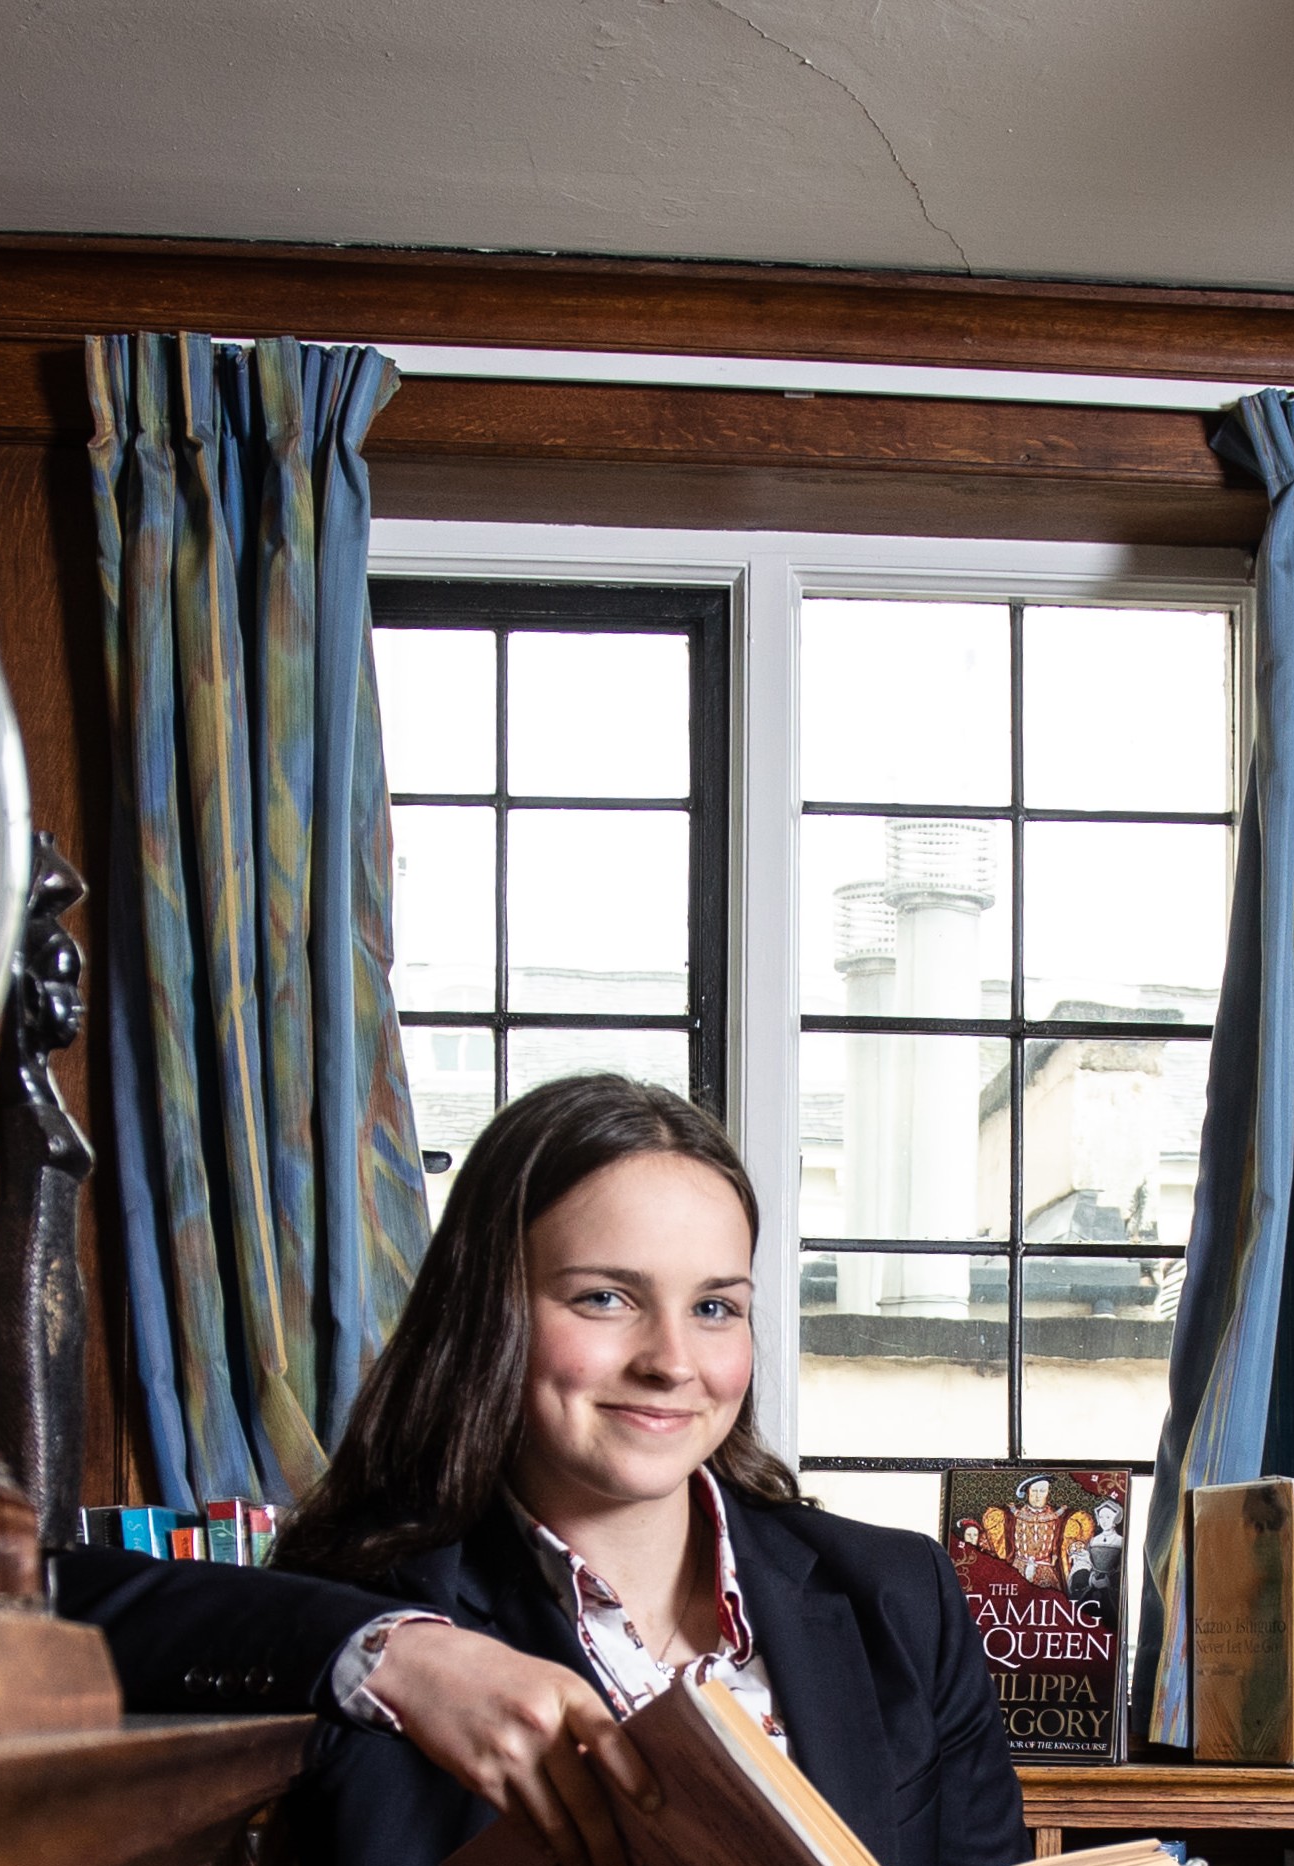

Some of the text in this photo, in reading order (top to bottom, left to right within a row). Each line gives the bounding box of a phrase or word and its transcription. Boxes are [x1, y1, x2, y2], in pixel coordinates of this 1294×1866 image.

[989, 1584, 1018, 1596] THE
[983, 1627, 1113, 1669] QUEEN
[991, 1673, 1098, 1704] ILIPPA
